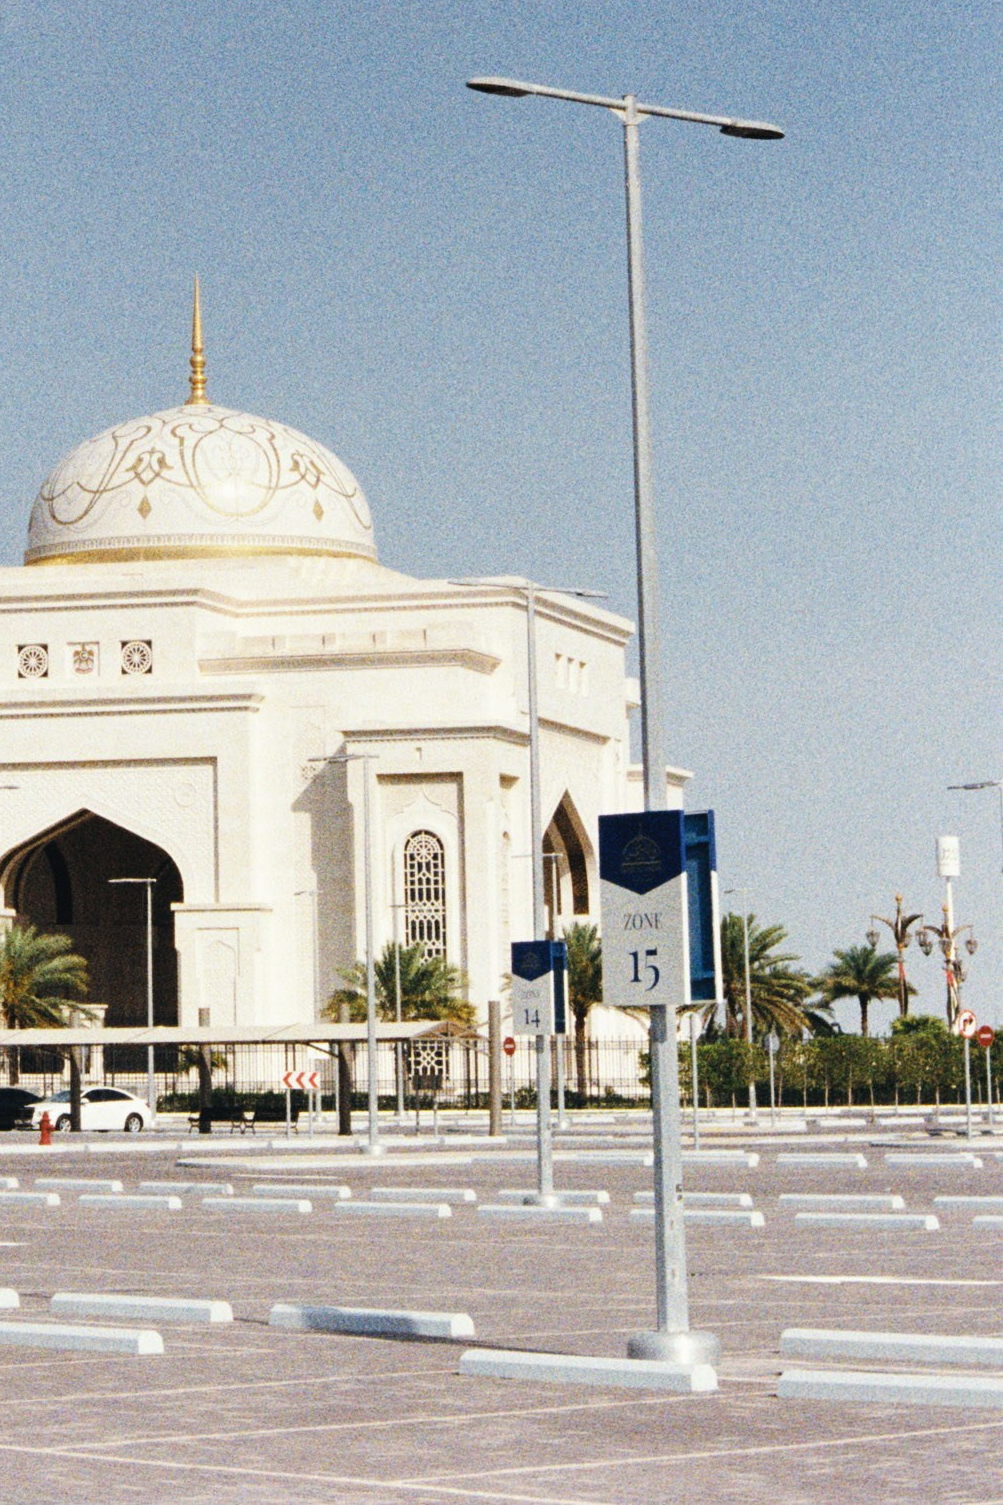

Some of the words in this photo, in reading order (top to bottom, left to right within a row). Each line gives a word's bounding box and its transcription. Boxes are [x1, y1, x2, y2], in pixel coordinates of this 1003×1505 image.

[623, 912, 663, 930] ZONE
[628, 947, 660, 991] 15
[524, 1009, 540, 1028] 14
